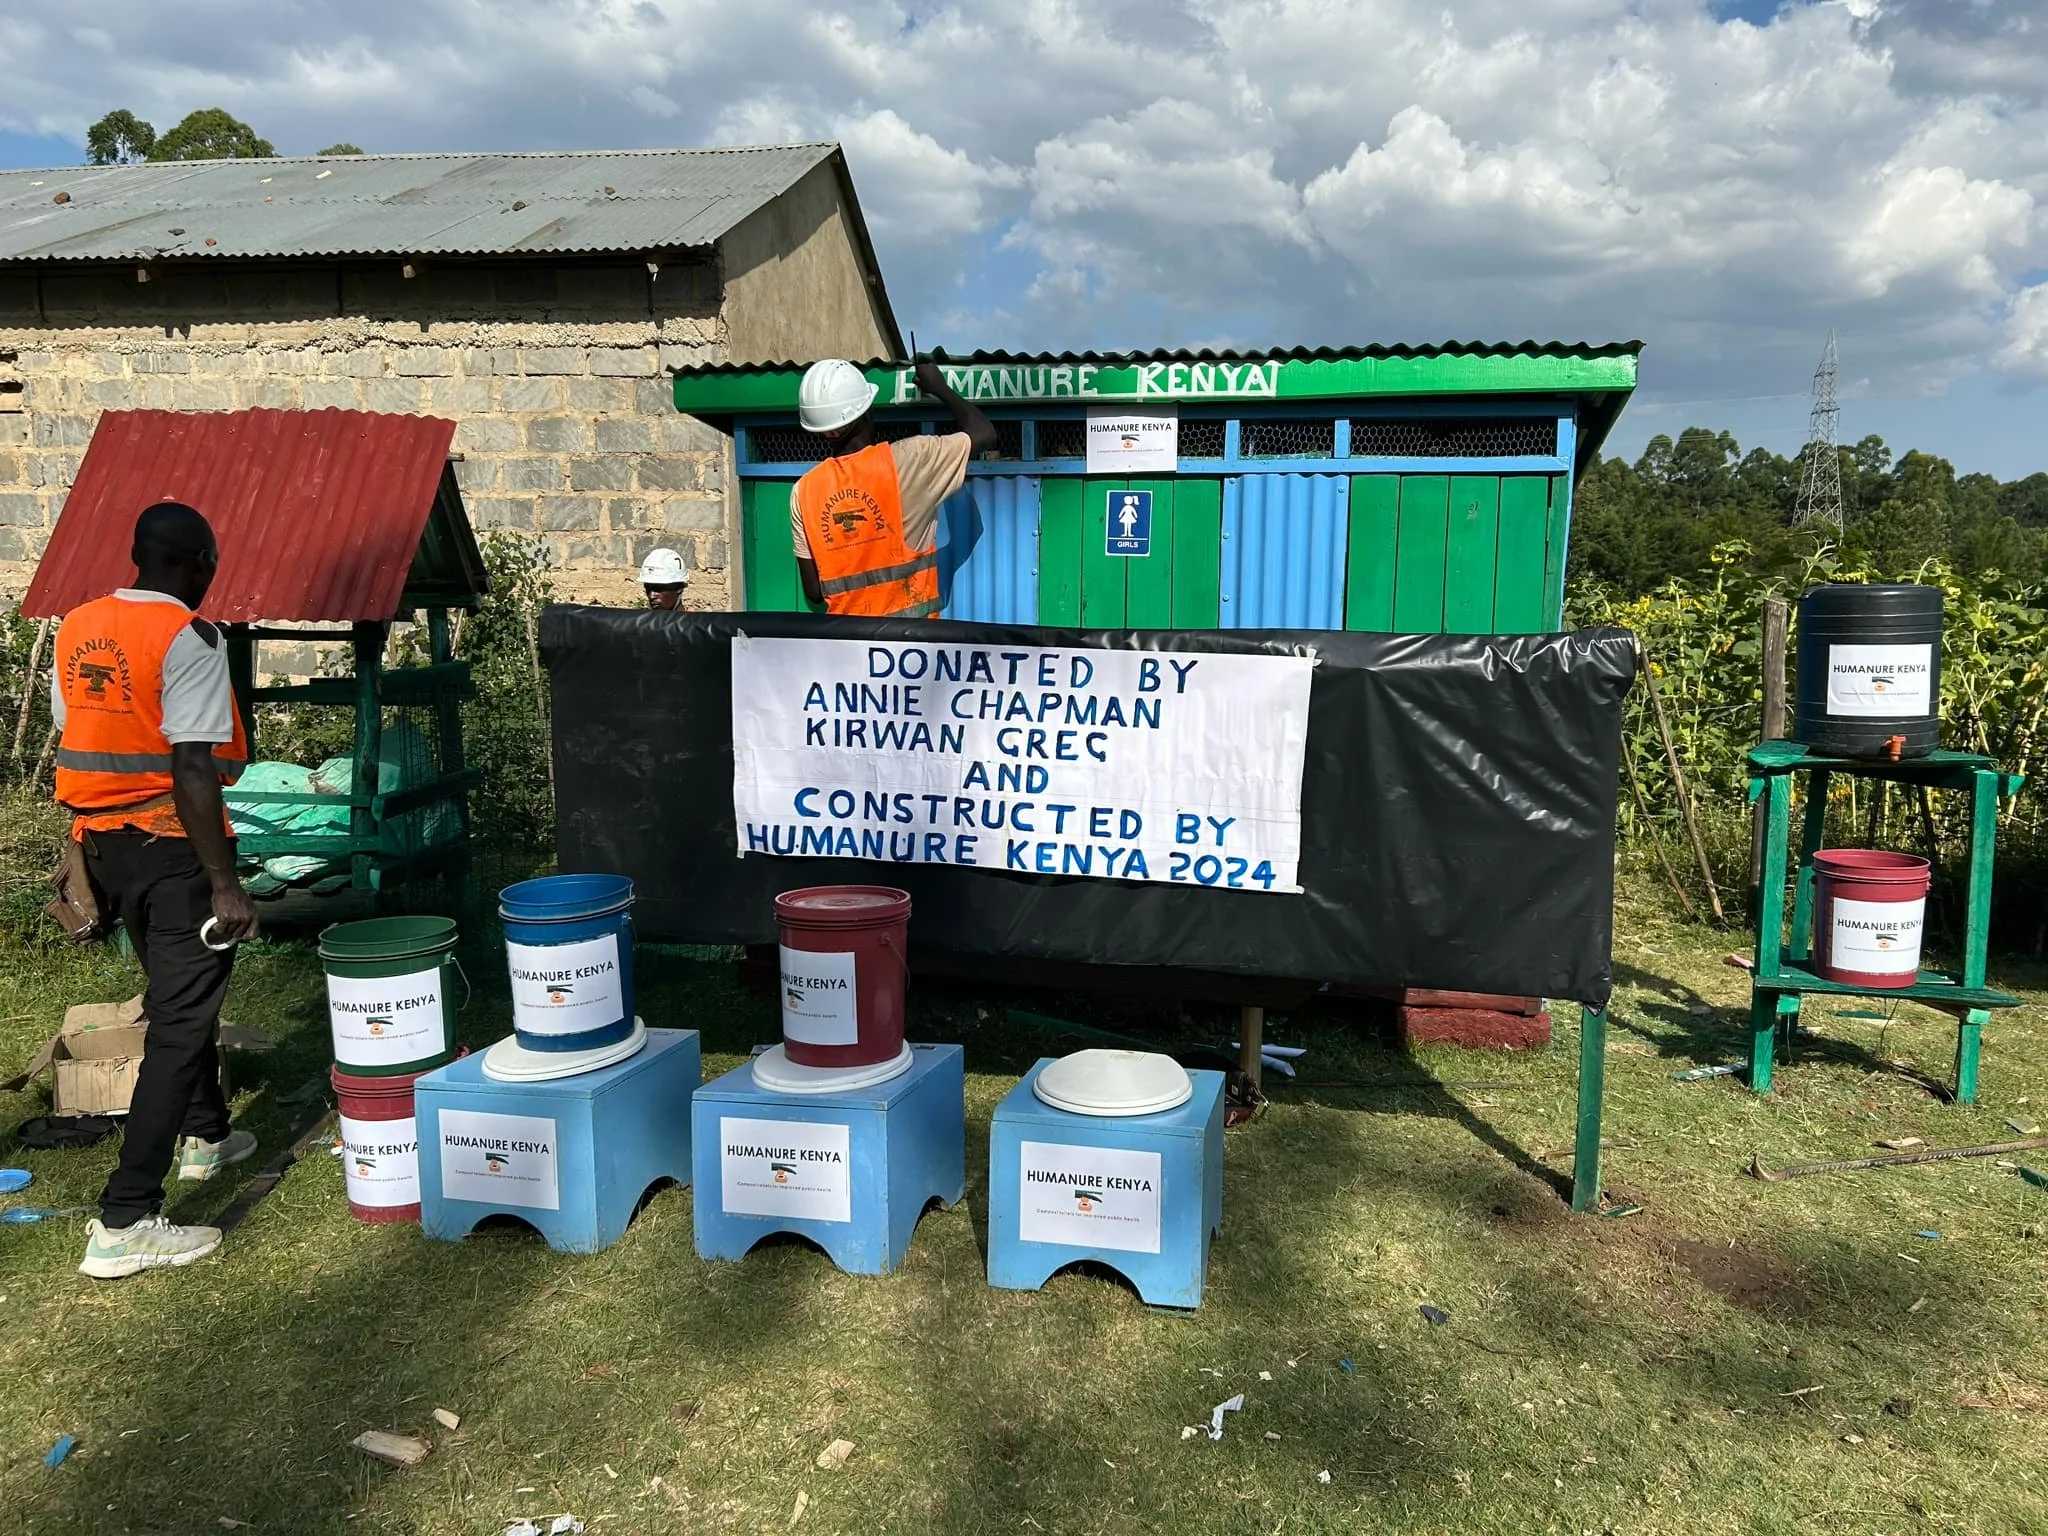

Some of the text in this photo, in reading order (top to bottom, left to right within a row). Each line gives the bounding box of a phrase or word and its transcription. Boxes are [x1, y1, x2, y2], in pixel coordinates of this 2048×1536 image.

[893, 362, 1268, 403] HMANURE KENYA
[1090, 422, 1172, 432] HUMANURE KENYA
[821, 488, 885, 544] HUMANURE KENYA
[114, 648, 133, 702] KENYA
[868, 647, 1198, 693] DONATED BY
[1833, 664, 1927, 674] HUMANURE KENYA
[803, 682, 1162, 729] ANNIE CHAPMAN
[806, 717, 965, 754] KIRWAN
[963, 761, 1049, 794] AND
[794, 787, 1237, 846] CONSTRUCTED BY
[747, 823, 1277, 889] HUMANURE KENYA 2024
[1837, 918, 1899, 931] HUMANURE
[512, 961, 615, 982] HUMANURE KENYA
[807, 977, 848, 989] KENYA
[332, 994, 436, 1014] HUMANURE KENYA
[445, 1135, 550, 1155] HUMANURE KENYA
[727, 1144, 842, 1163] HUMANURE KENYA
[1027, 1169, 1152, 1192] HUMANURE KENYA
